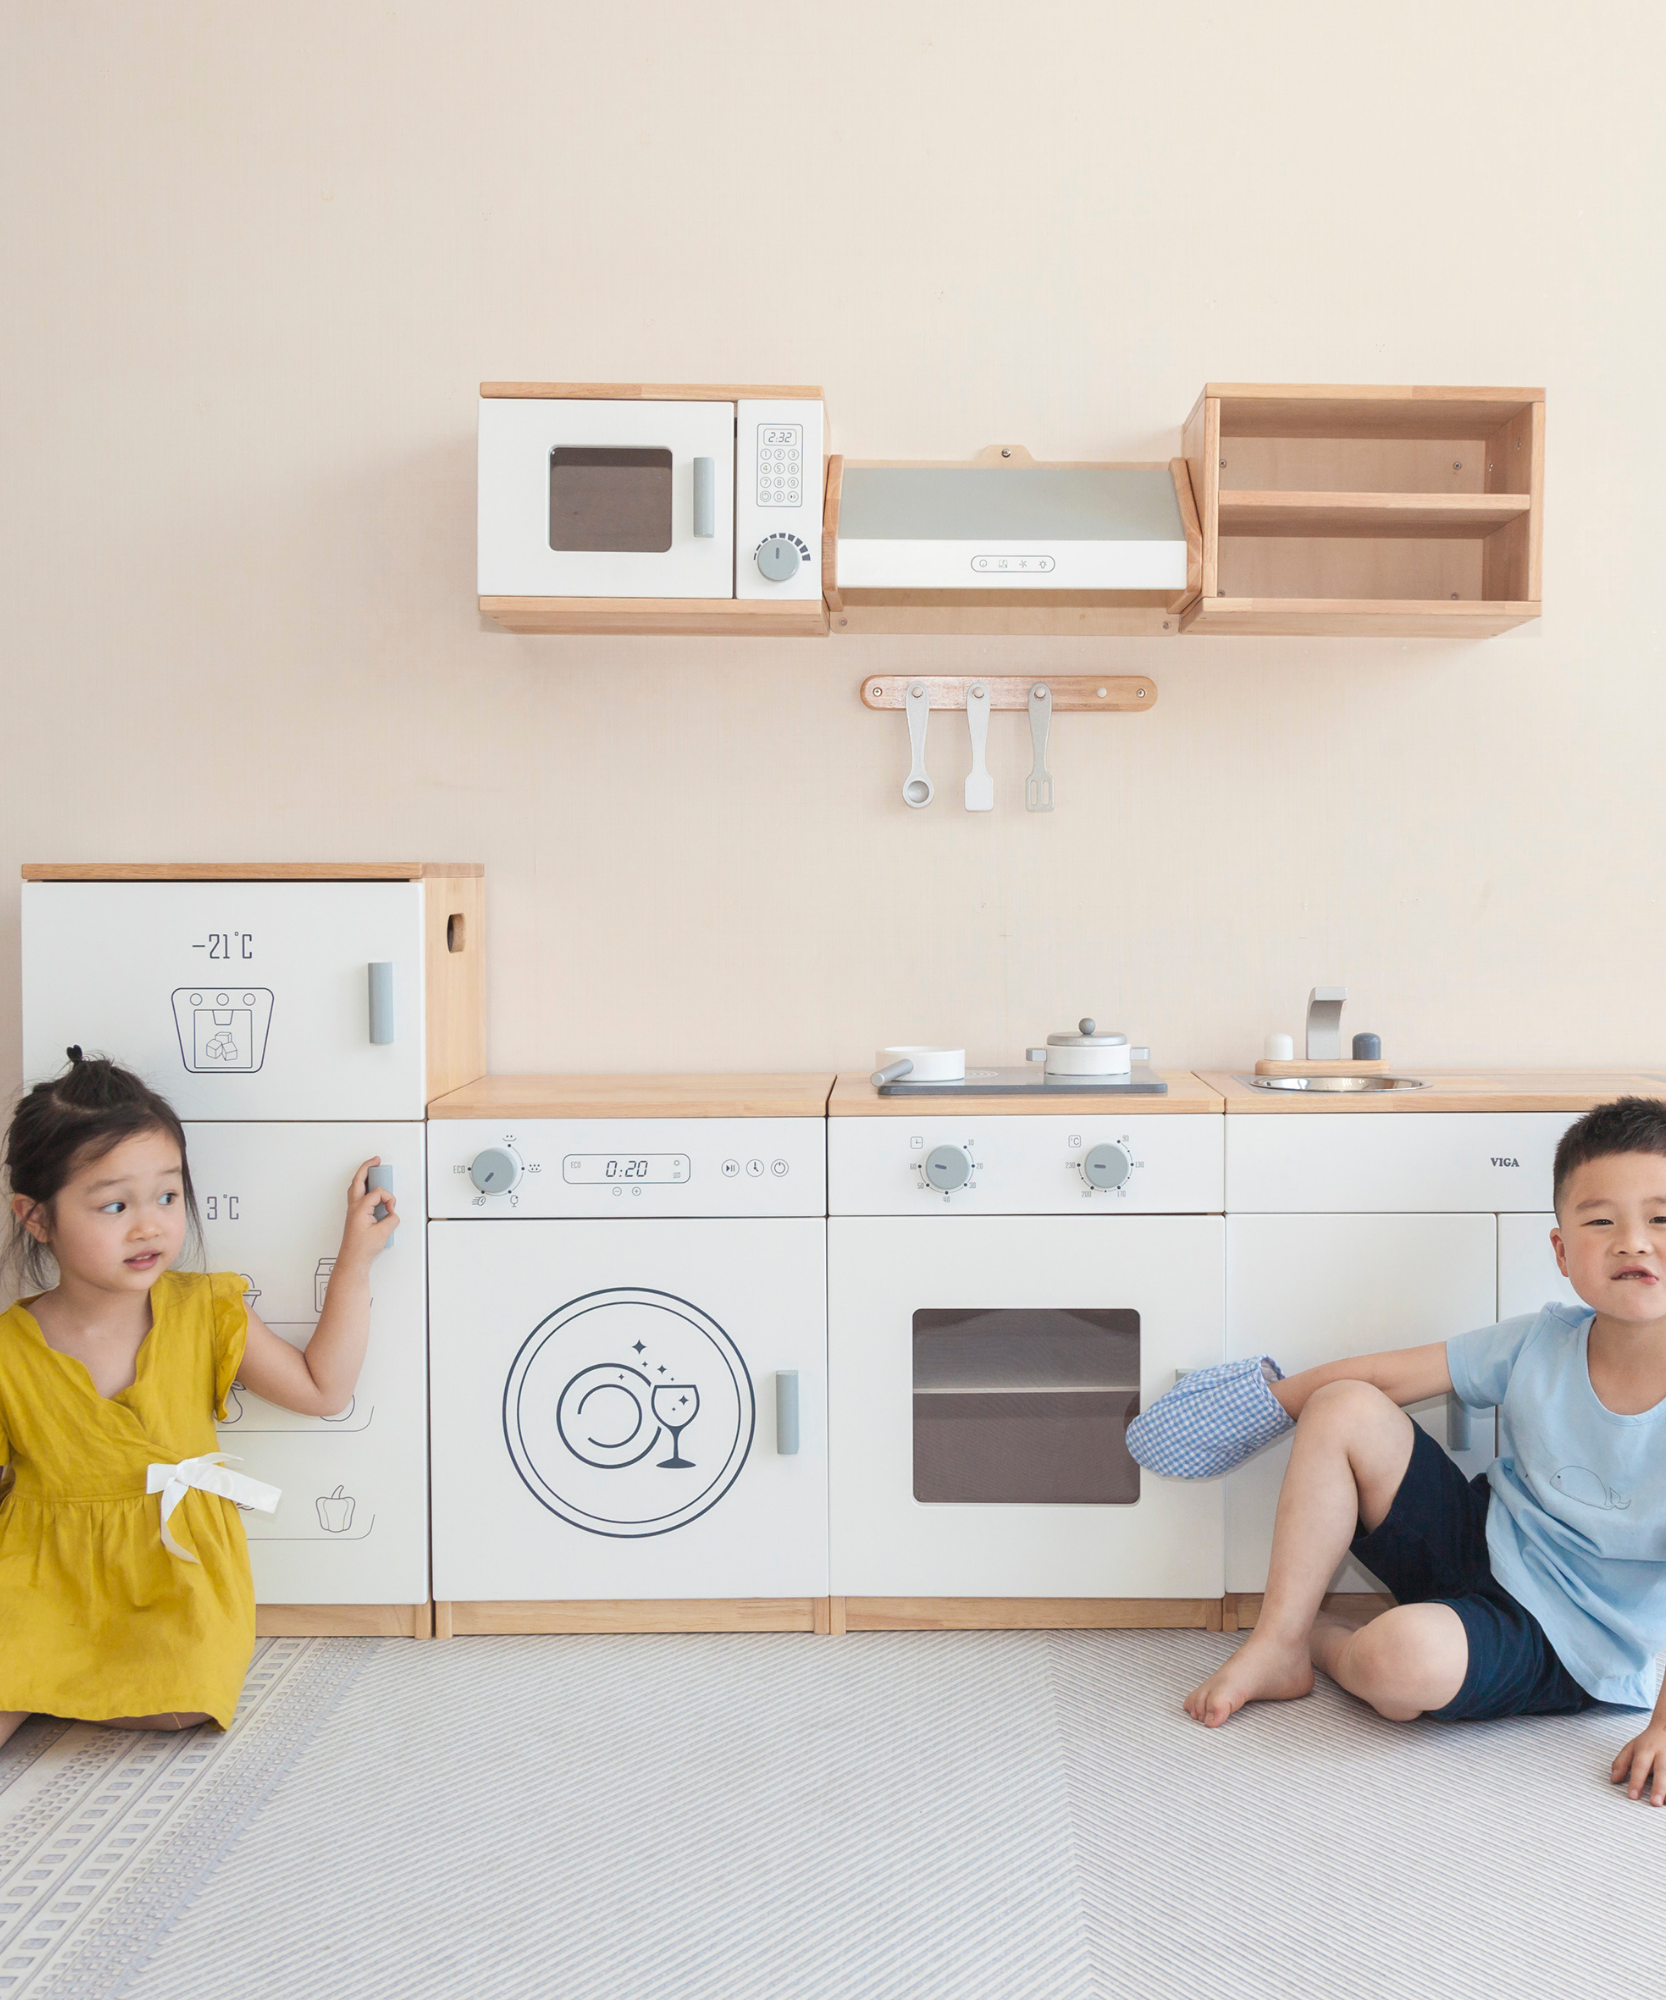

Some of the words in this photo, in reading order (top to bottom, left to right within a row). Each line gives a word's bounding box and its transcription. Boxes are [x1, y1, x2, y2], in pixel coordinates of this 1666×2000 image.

[768, 432, 793, 443] 2:32
[764, 450, 768, 458] 1
[777, 450, 782, 458] 2
[791, 451, 796, 459] 3
[776, 465, 782, 473] 5
[791, 465, 796, 473] 6
[763, 478, 769, 486] 7
[776, 479, 782, 487] 8
[790, 479, 796, 487] 9
[570, 1161, 582, 1169] ECO
[1490, 1157, 1520, 1168] VIGA
[453, 1165, 466, 1174] ECO
[605, 1160, 649, 1178] 0:20
